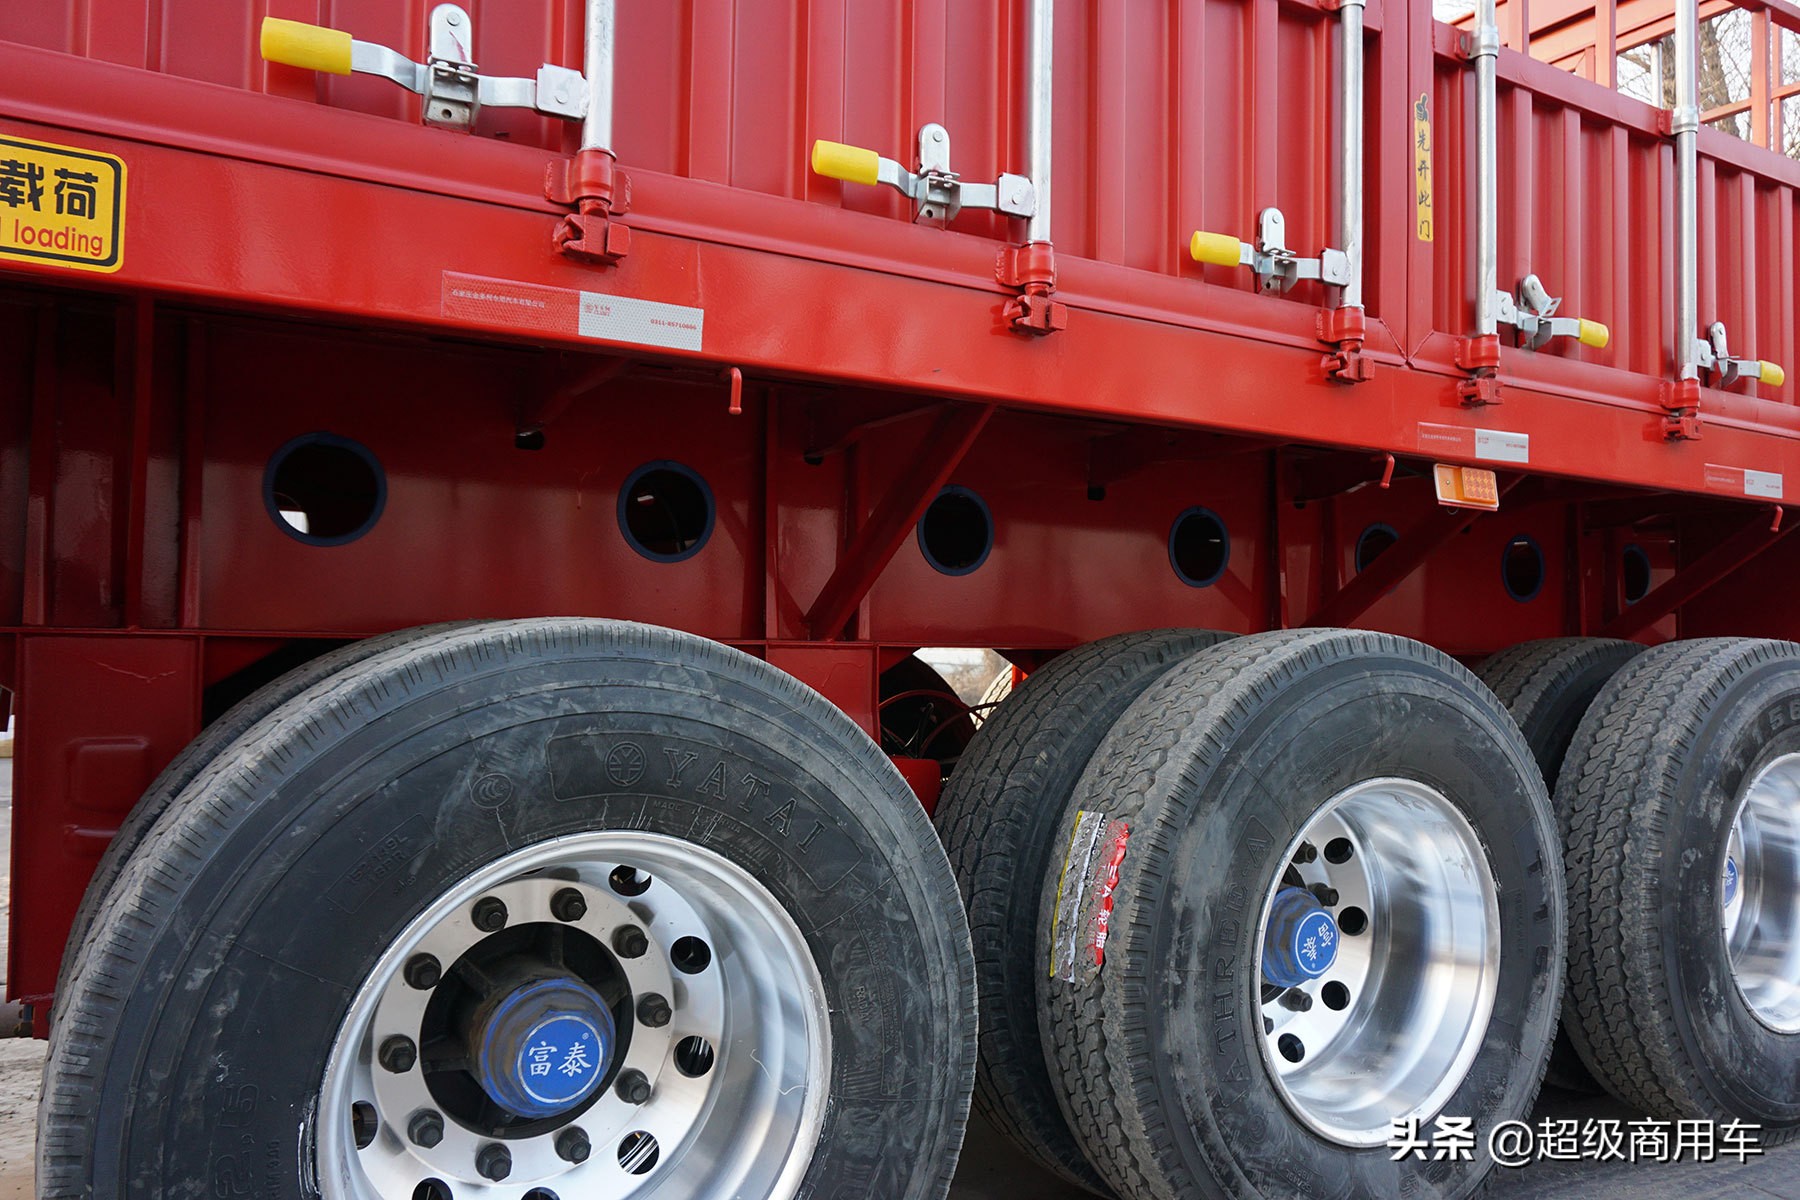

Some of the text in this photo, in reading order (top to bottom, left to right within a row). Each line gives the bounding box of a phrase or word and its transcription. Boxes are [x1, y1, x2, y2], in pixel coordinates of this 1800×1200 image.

[0, 159, 98, 220] 载荷
[1416, 128, 1431, 239] 先开此门
[14, 218, 104, 257] loading
[663, 747, 827, 855] YATAI
[1301, 922, 1334, 961] 富泰
[528, 1040, 592, 1078] 富泰
